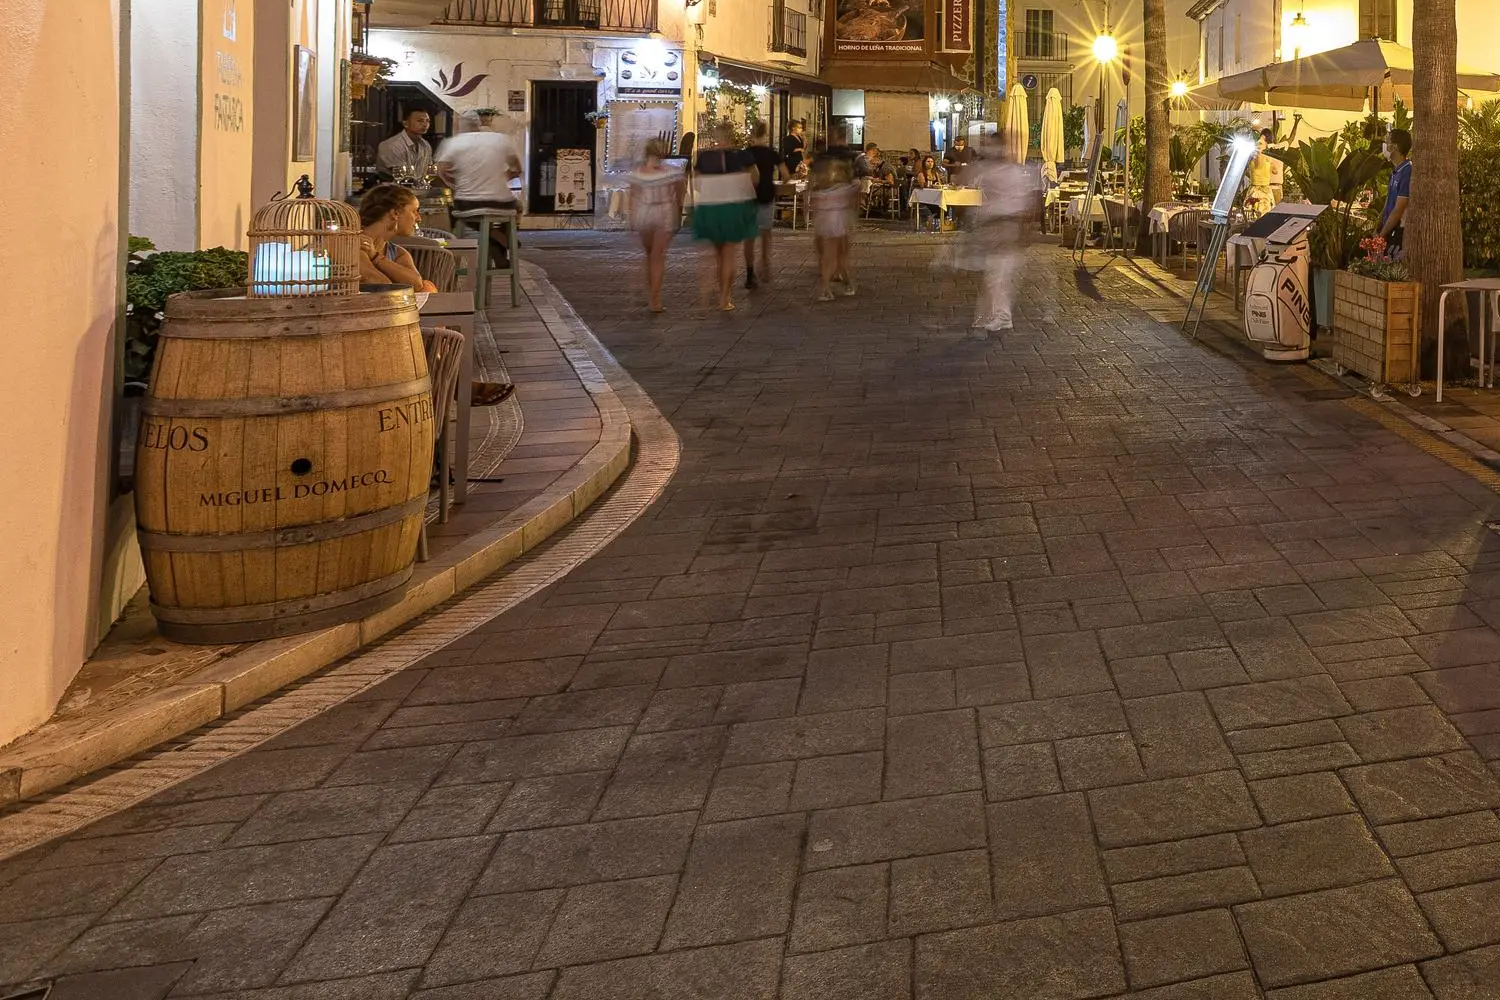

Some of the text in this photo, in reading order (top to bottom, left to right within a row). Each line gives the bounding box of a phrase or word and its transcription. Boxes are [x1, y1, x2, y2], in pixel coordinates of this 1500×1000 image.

[1281, 278, 1310, 327] PING
[144, 399, 432, 452] ELOS ENTR
[199, 469, 396, 507] MIGUEL DOMECQ
